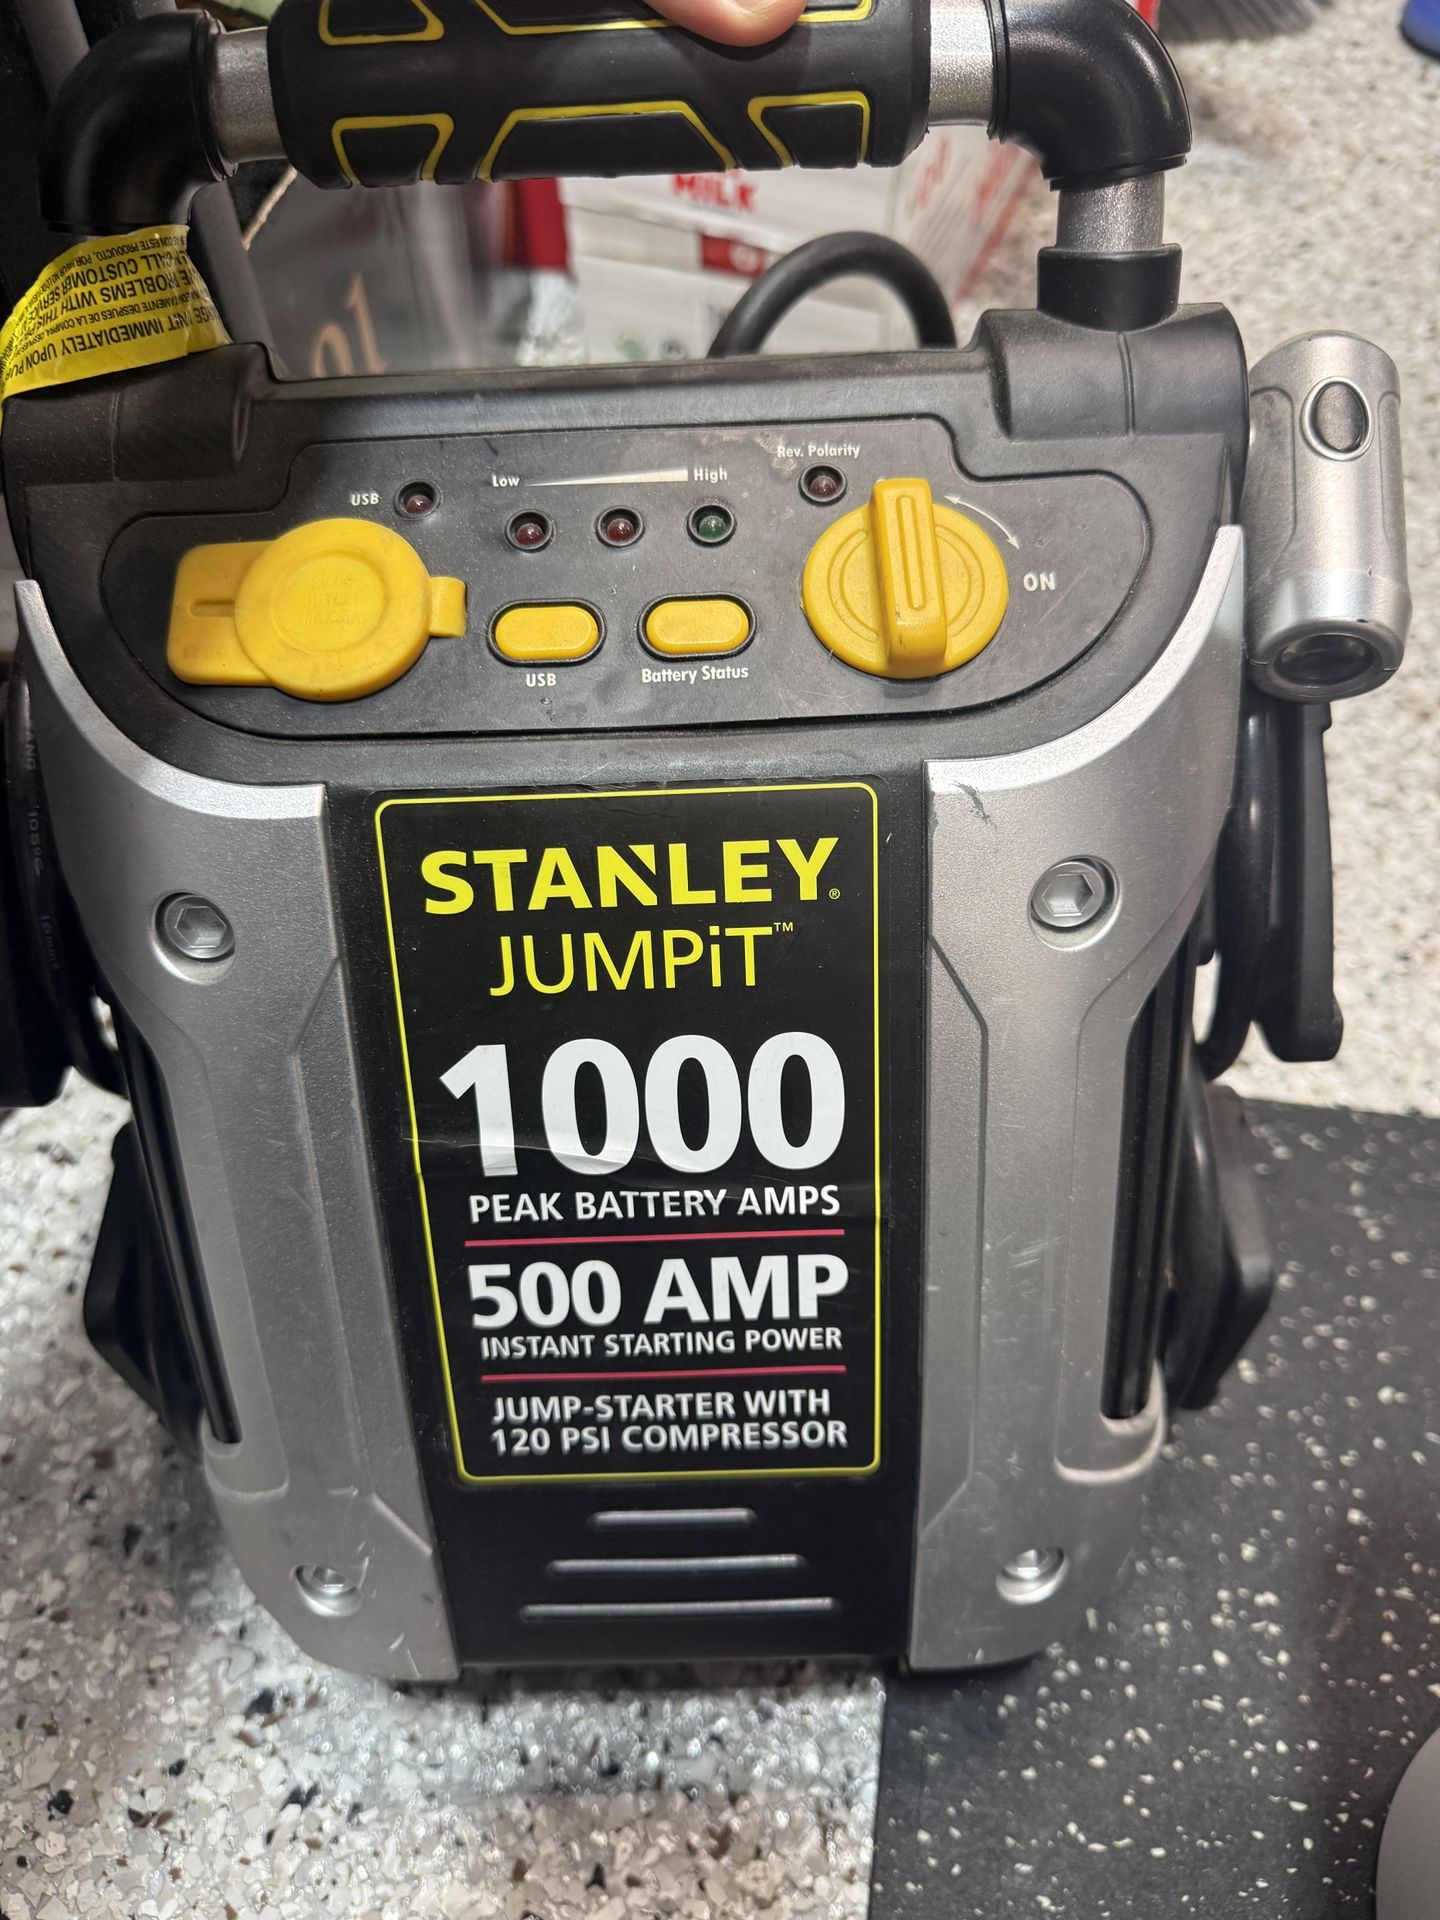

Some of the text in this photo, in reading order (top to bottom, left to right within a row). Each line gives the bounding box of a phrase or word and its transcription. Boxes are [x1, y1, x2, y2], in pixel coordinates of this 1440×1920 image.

[61, 257, 139, 296] CUSTOMER
[61, 290, 98, 315] WITH
[62, 317, 164, 355] IMMEDIATELY
[26, 343, 57, 370] UPON
[777, 441, 860, 460] Rev. Polarity
[492, 467, 728, 488] Low High
[351, 493, 380, 506] USB
[1023, 572, 1056, 592] ON
[526, 673, 557, 687] USB
[641, 665, 749, 684] Battery Status
[440, 1032, 845, 1177] 1000
[469, 1184, 841, 1223] PEAK BATTERY AMPS
[468, 1254, 849, 1328] 500 AMP
[481, 1327, 843, 1359] INSTANT STARTING POWER
[492, 1388, 831, 1423] JUMP-STARTER WITH
[491, 1420, 848, 1455] 120 PSI COMPRESSOR
